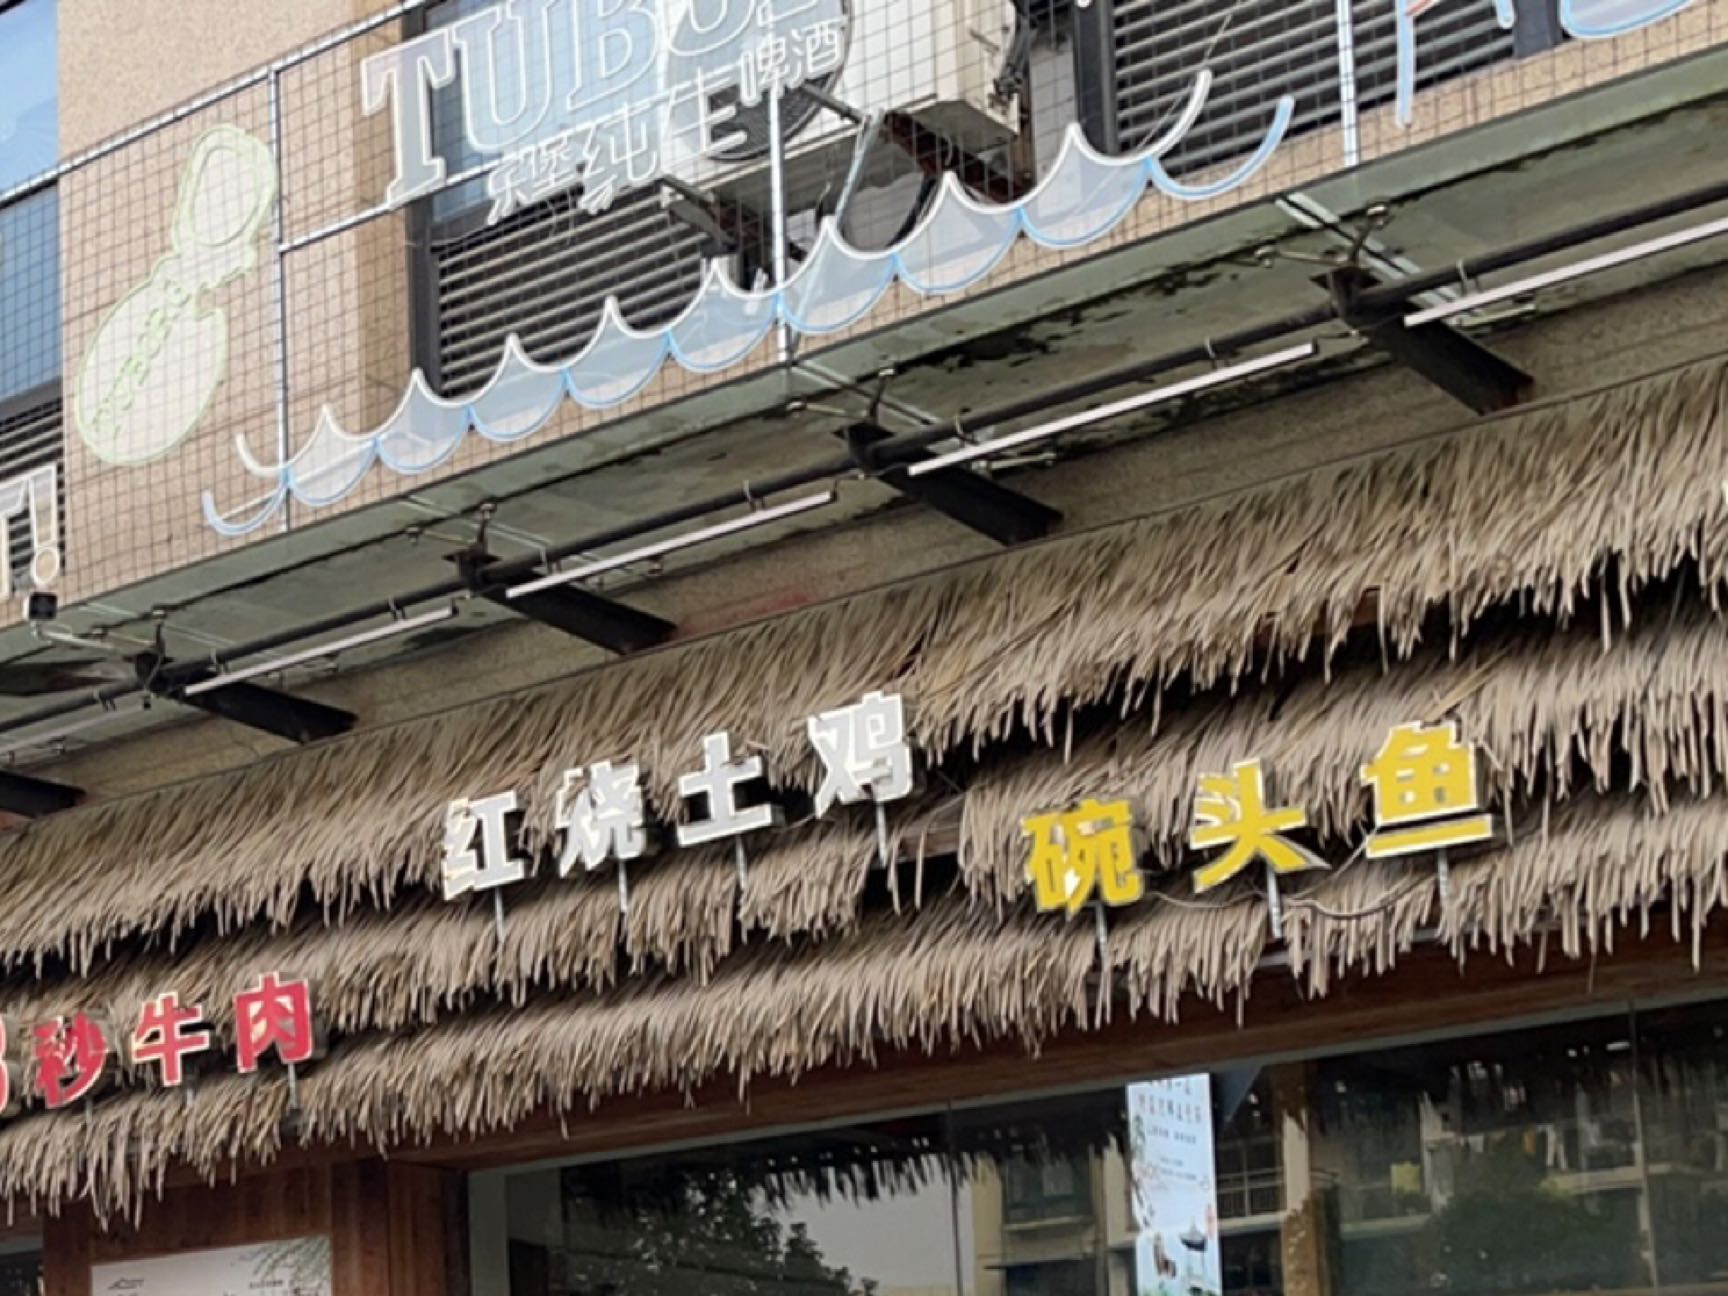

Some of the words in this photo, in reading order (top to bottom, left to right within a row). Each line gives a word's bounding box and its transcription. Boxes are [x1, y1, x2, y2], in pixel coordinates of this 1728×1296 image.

[360, 0, 821, 210] TUB
[487, 14, 847, 226] 乐堡纯生啤酒
[443, 690, 917, 902] 红烧土鸡
[1021, 718, 1495, 915] 碗头鱼
